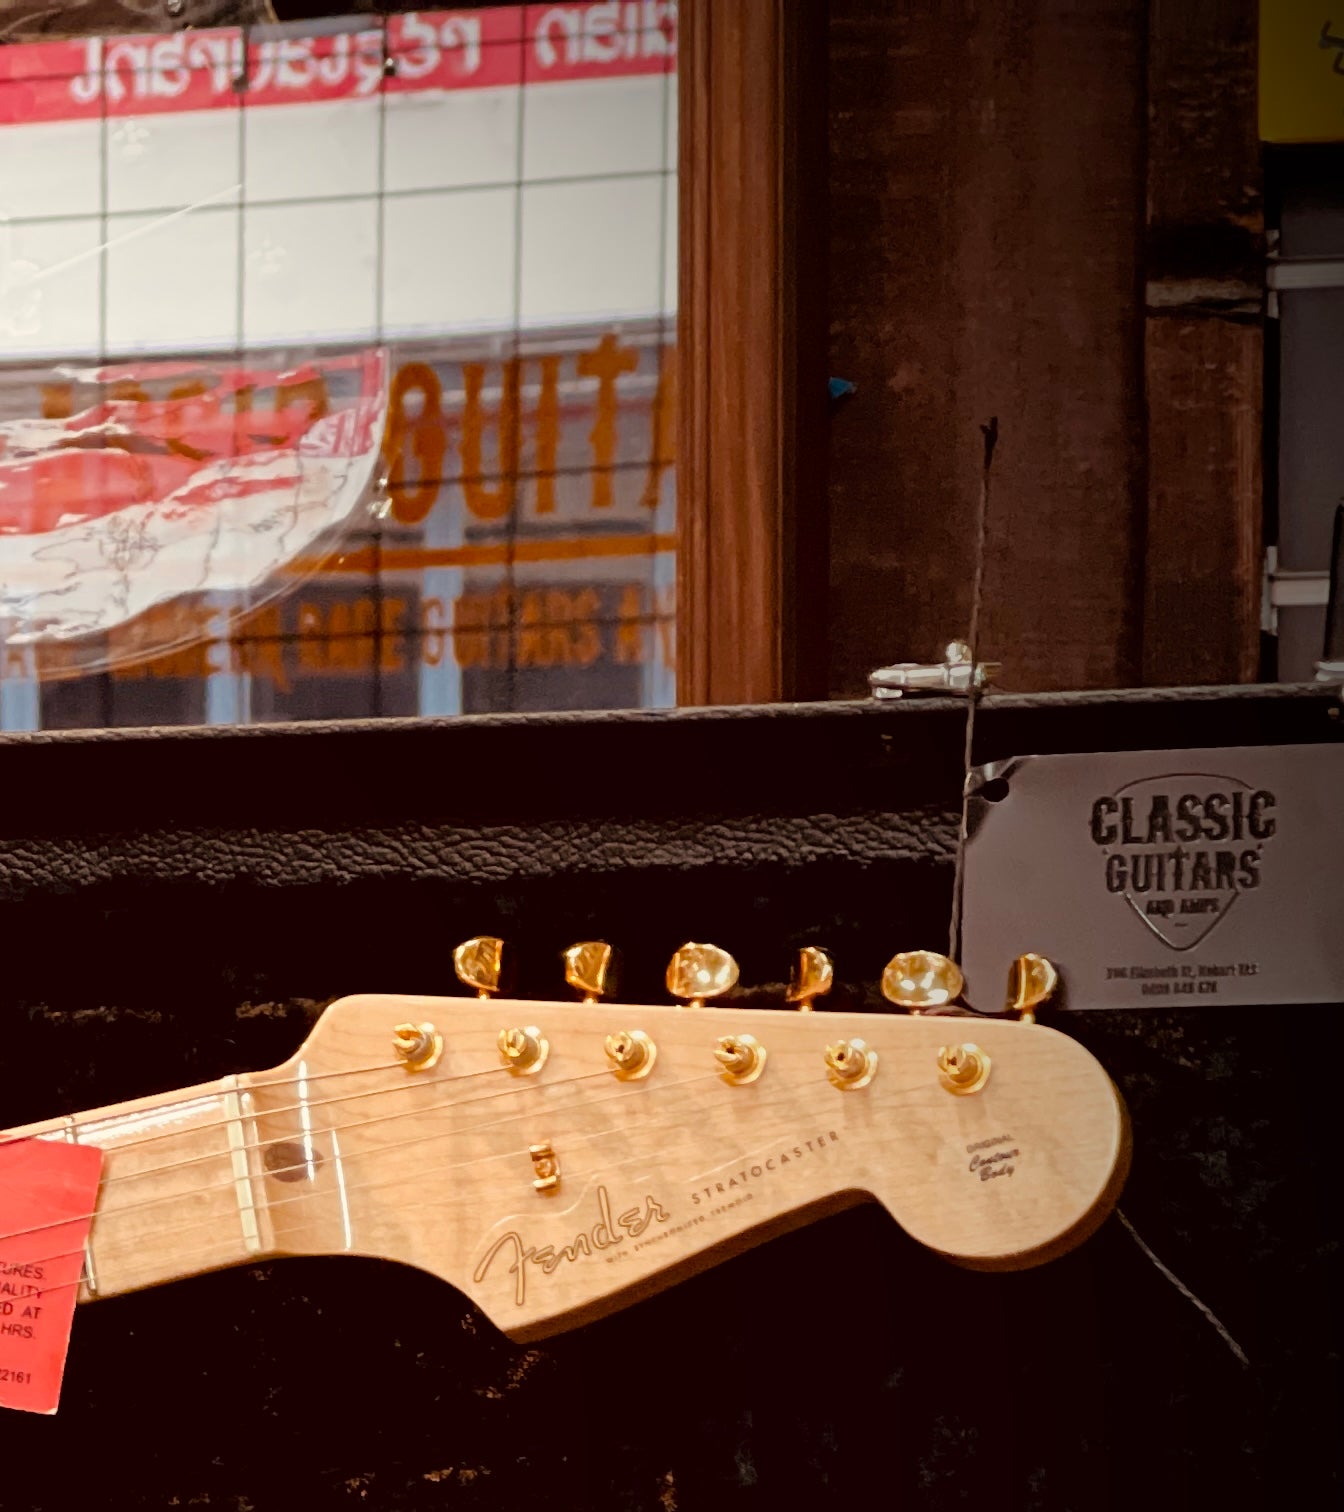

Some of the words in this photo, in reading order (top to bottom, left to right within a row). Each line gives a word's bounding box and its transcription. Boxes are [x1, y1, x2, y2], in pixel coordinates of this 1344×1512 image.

[1089, 789, 1278, 846] CLASSIC
[1104, 846, 1262, 894] GUITARS
[691, 1130, 840, 1205] STRATOCASTER
[473, 1184, 670, 1306] Fender
[21, 1305, 43, 1320] AT
